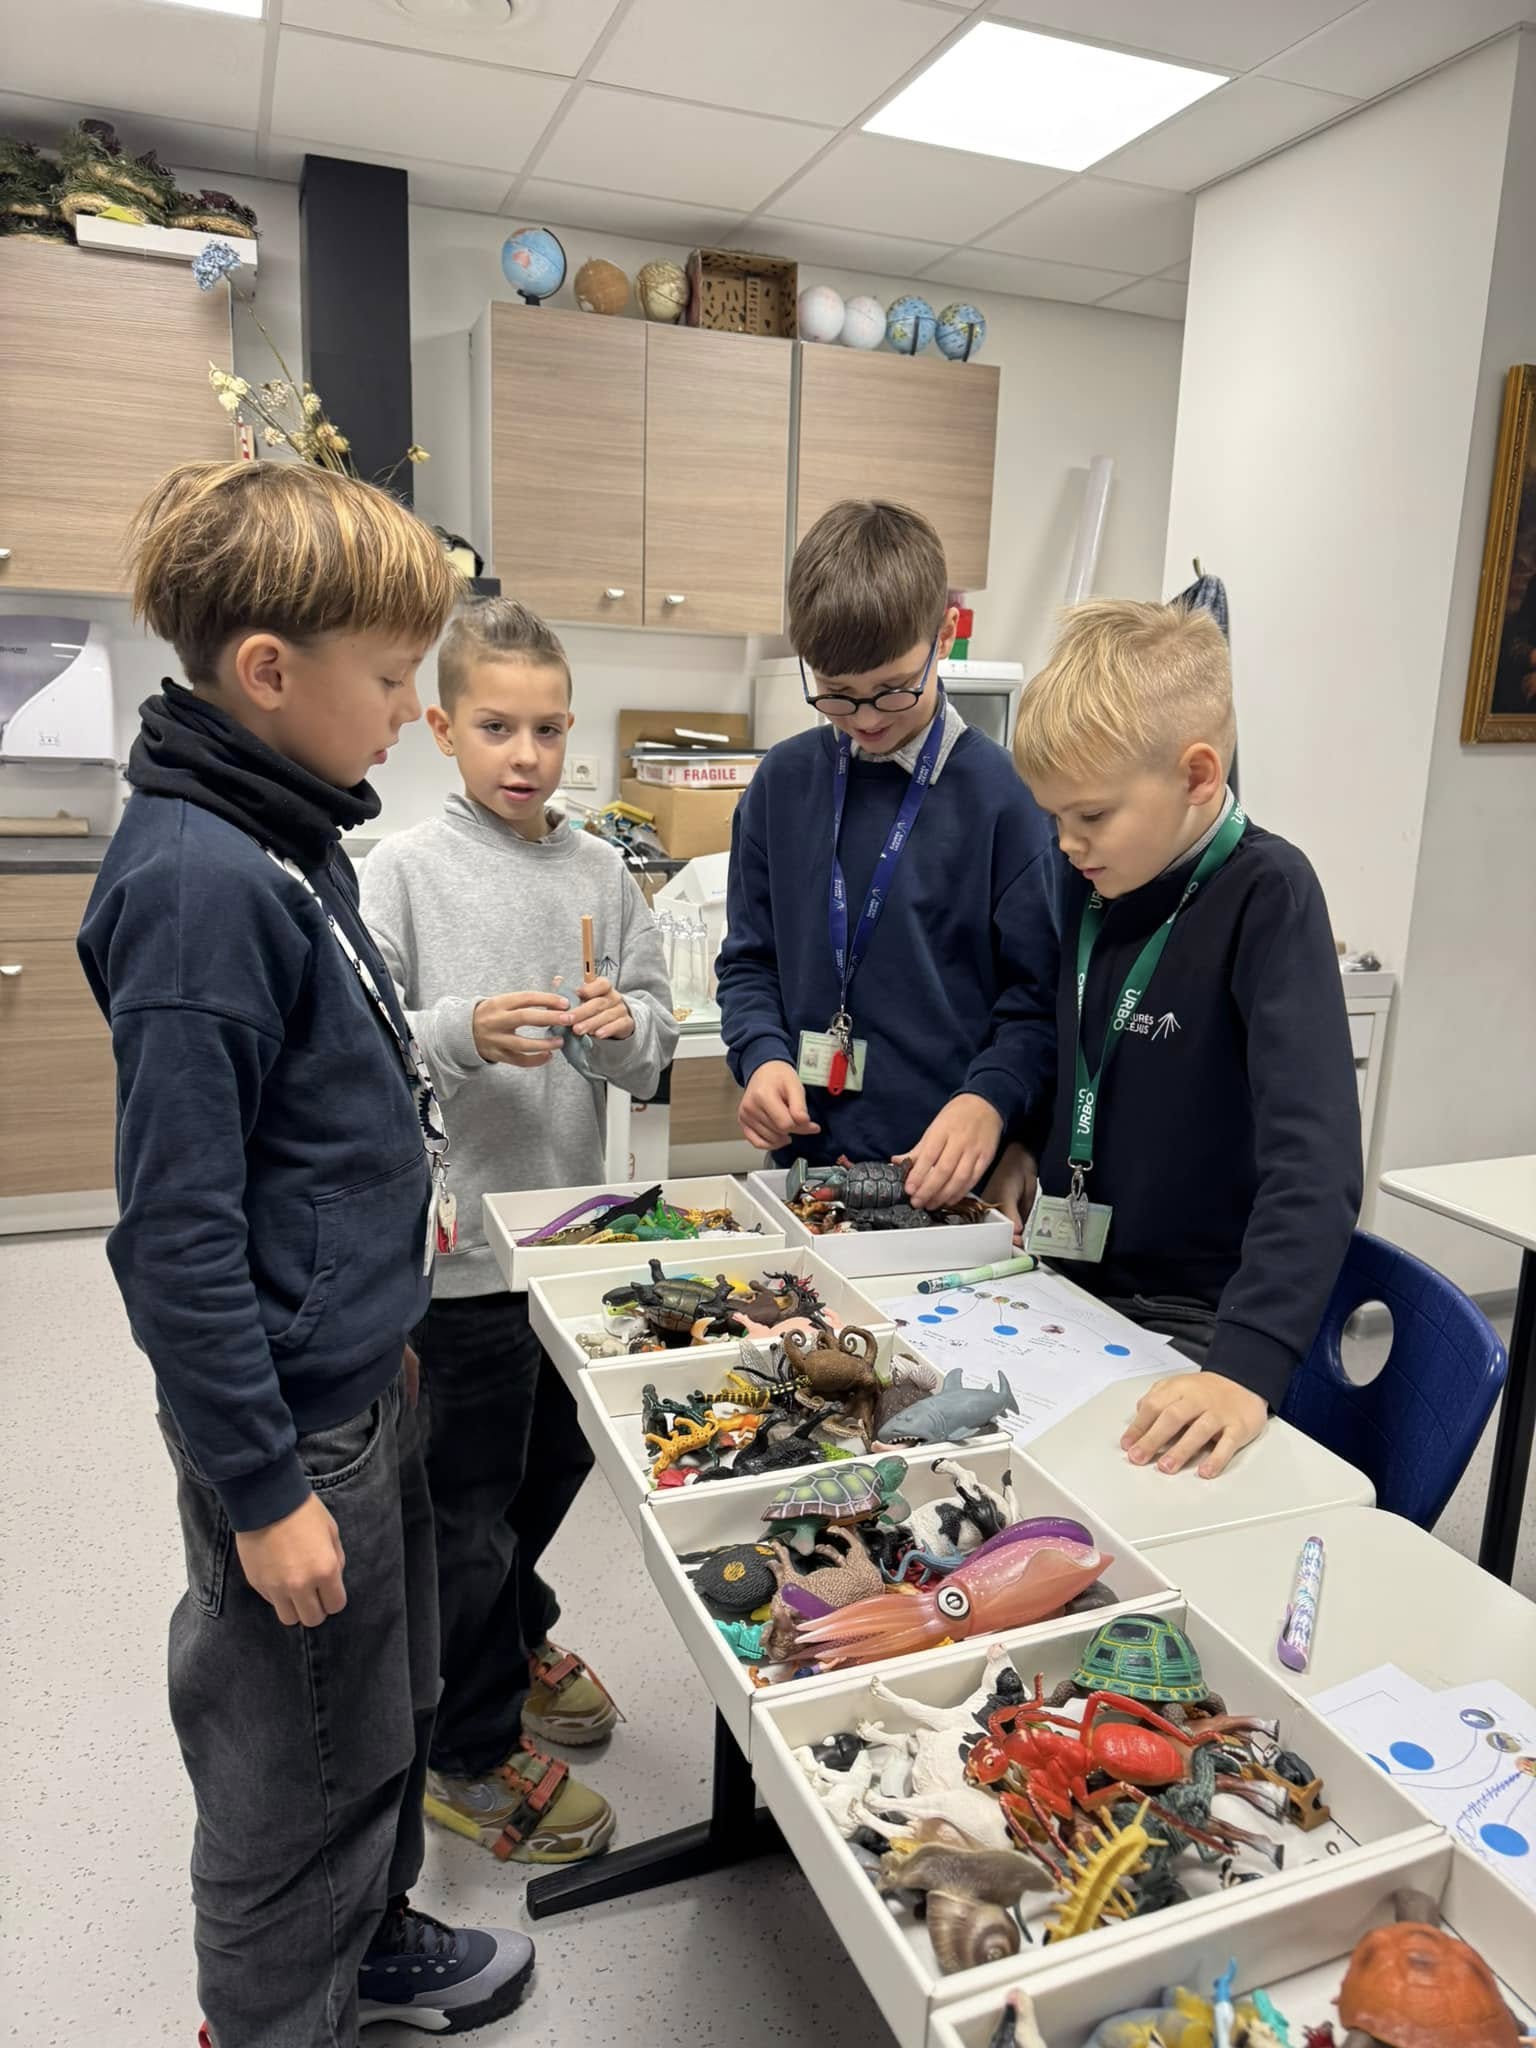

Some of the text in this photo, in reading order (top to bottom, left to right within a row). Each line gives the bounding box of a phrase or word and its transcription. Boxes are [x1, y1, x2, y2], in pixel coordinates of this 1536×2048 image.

[684, 768, 737, 781] FRAGILE
[1113, 988, 1142, 1031] URBO
[1130, 1013, 1155, 1026] URĖS
[1077, 1092, 1094, 1134] URBO
